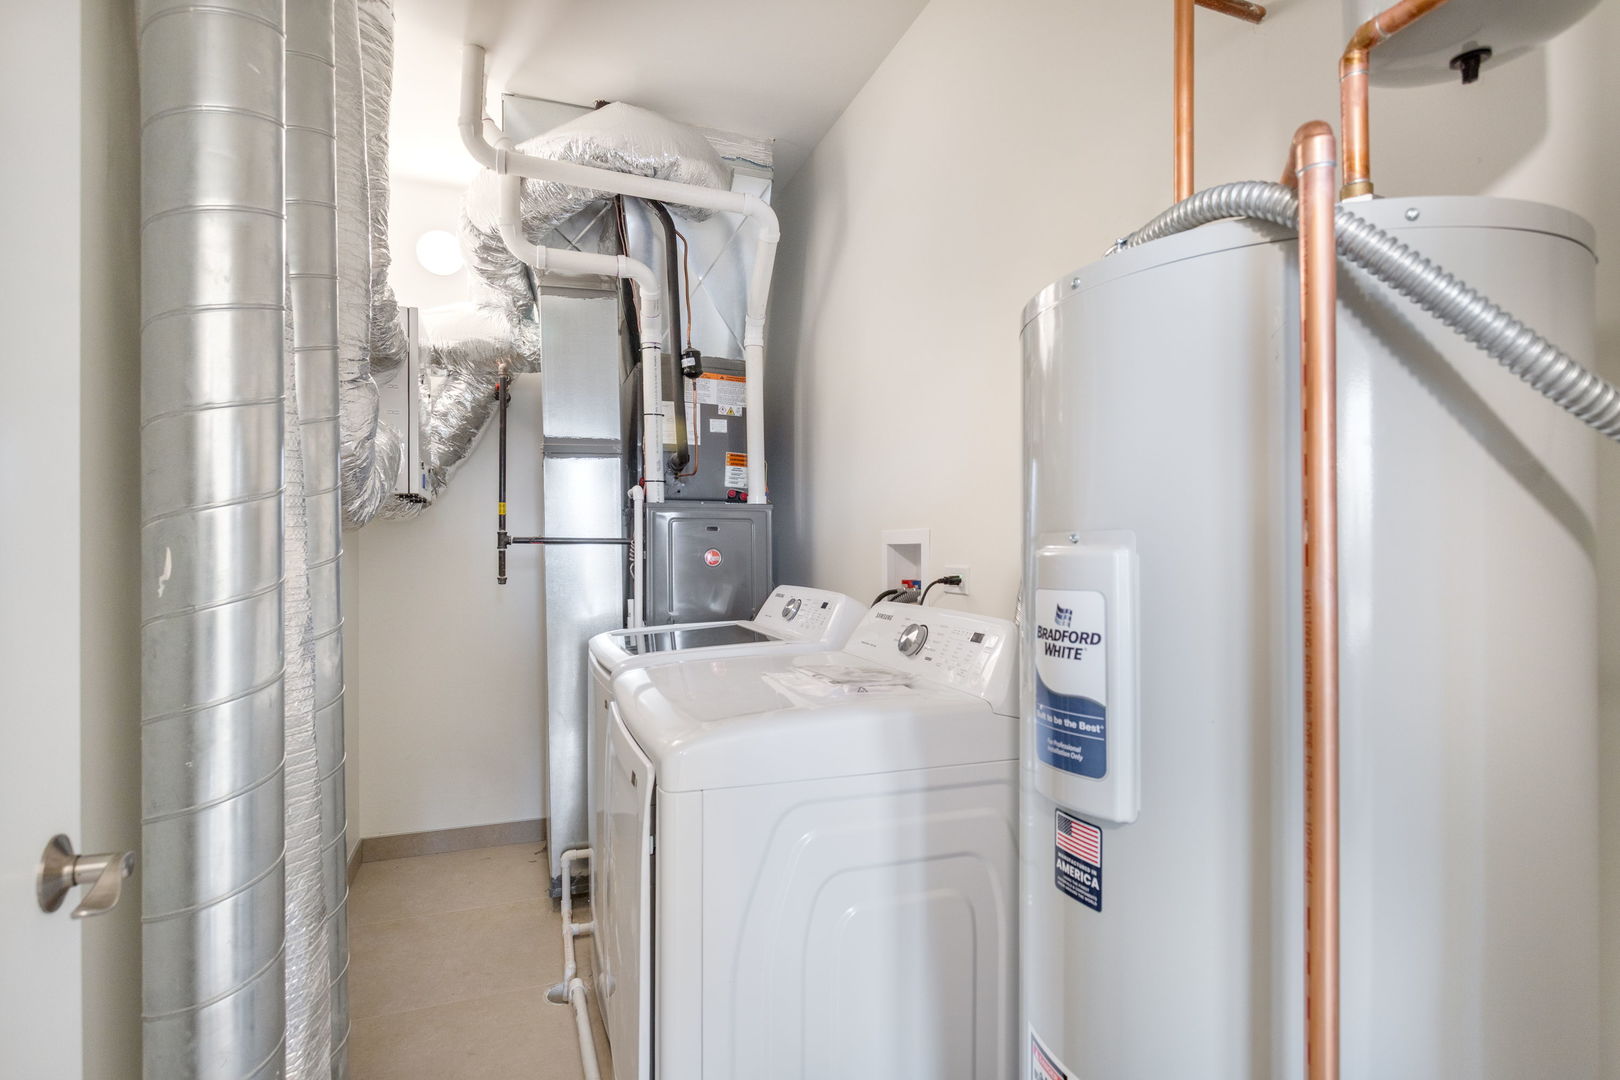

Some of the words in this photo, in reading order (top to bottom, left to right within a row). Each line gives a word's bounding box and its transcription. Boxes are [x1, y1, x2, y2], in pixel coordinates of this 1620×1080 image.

[1036, 625, 1102, 645] BRADFORD
[1044, 641, 1083, 661] WHITE
[1053, 714, 1063, 726] be
[1064, 718, 1077, 729] the
[1070, 752, 1084, 763] Only
[1056, 858, 1100, 891] AMERICA
